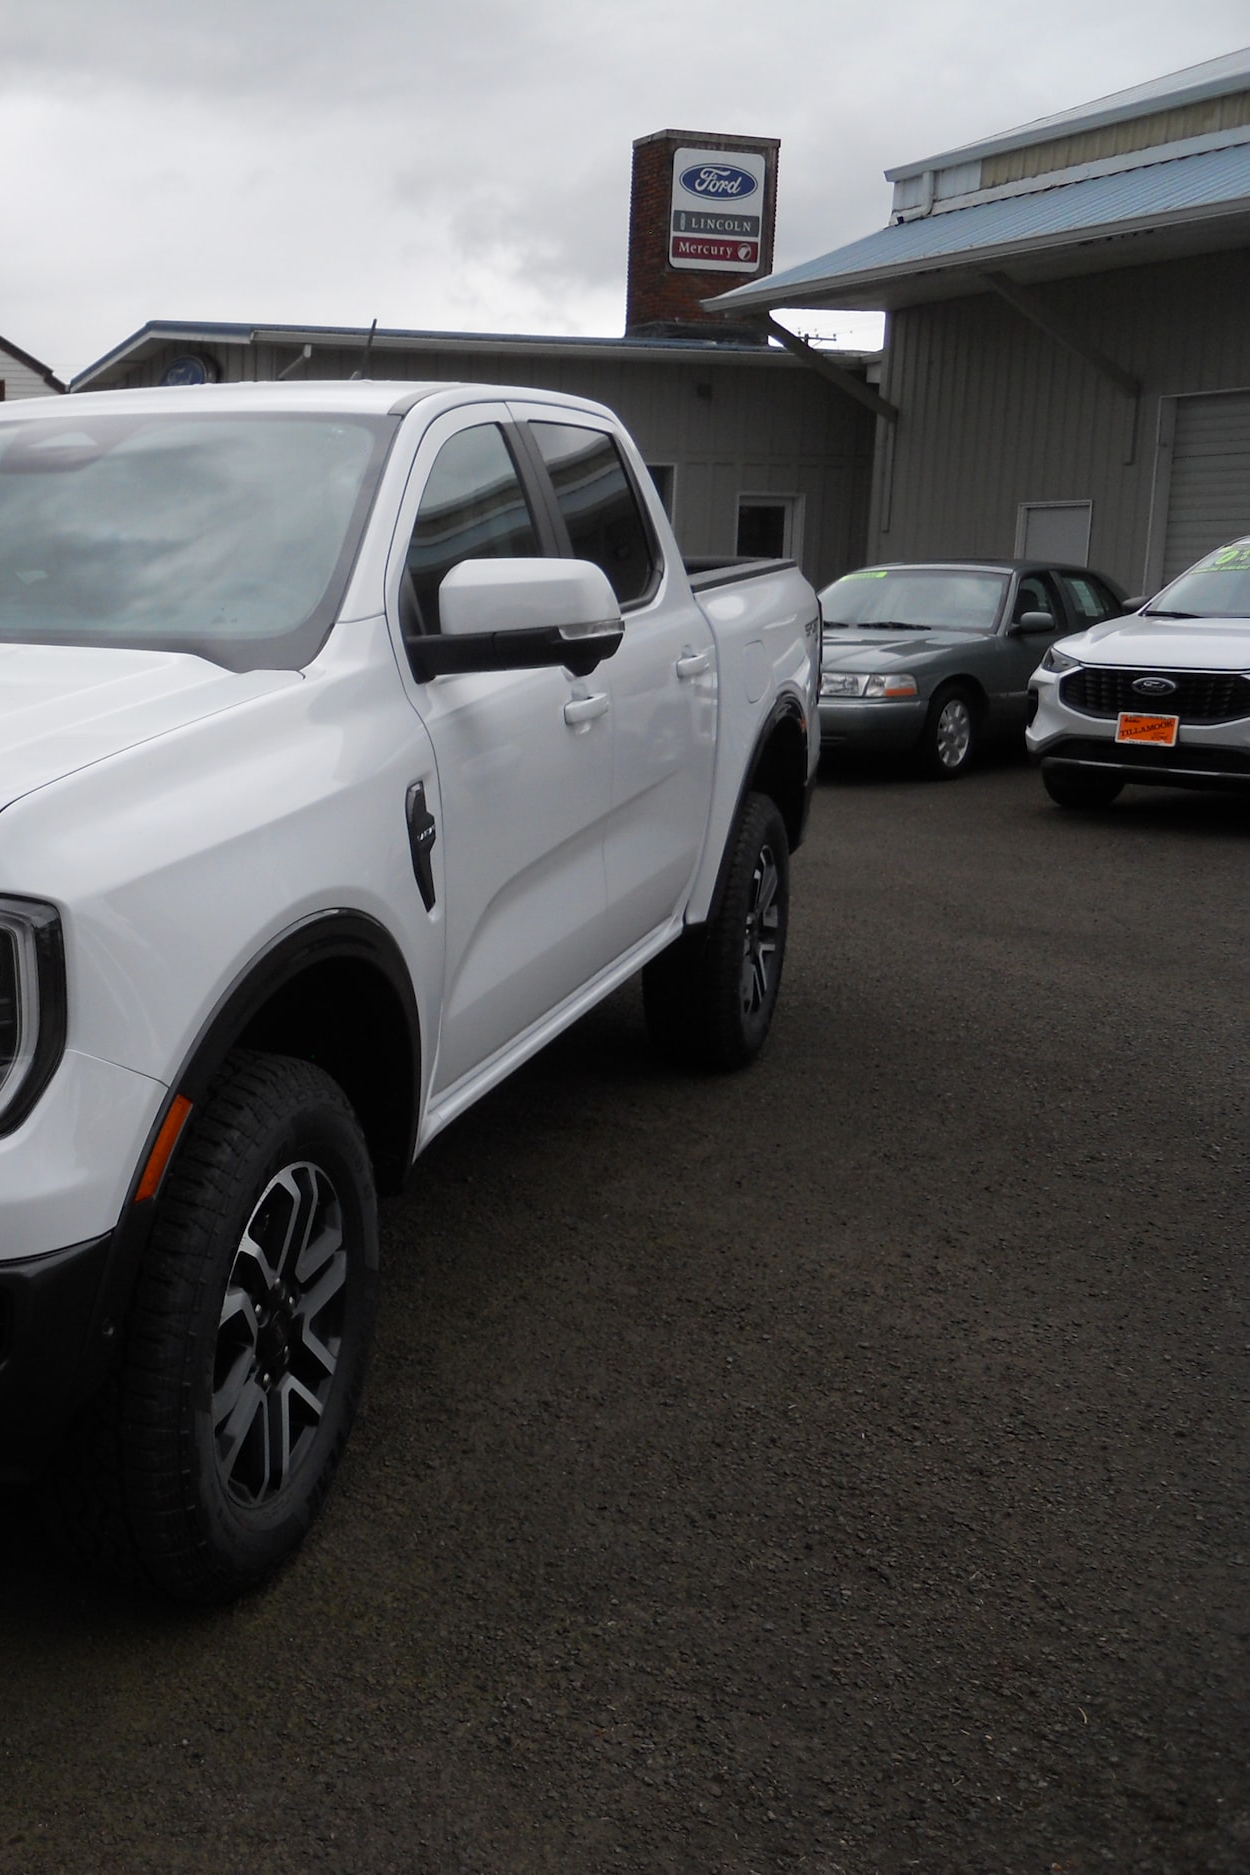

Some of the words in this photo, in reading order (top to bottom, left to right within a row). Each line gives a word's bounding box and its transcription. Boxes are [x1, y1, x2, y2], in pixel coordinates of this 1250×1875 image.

[695, 167, 742, 194] Ford
[691, 217, 751, 232] LINCOLN
[678, 241, 733, 258] Mercury
[1120, 720, 1174, 737] TILLAMOOK
